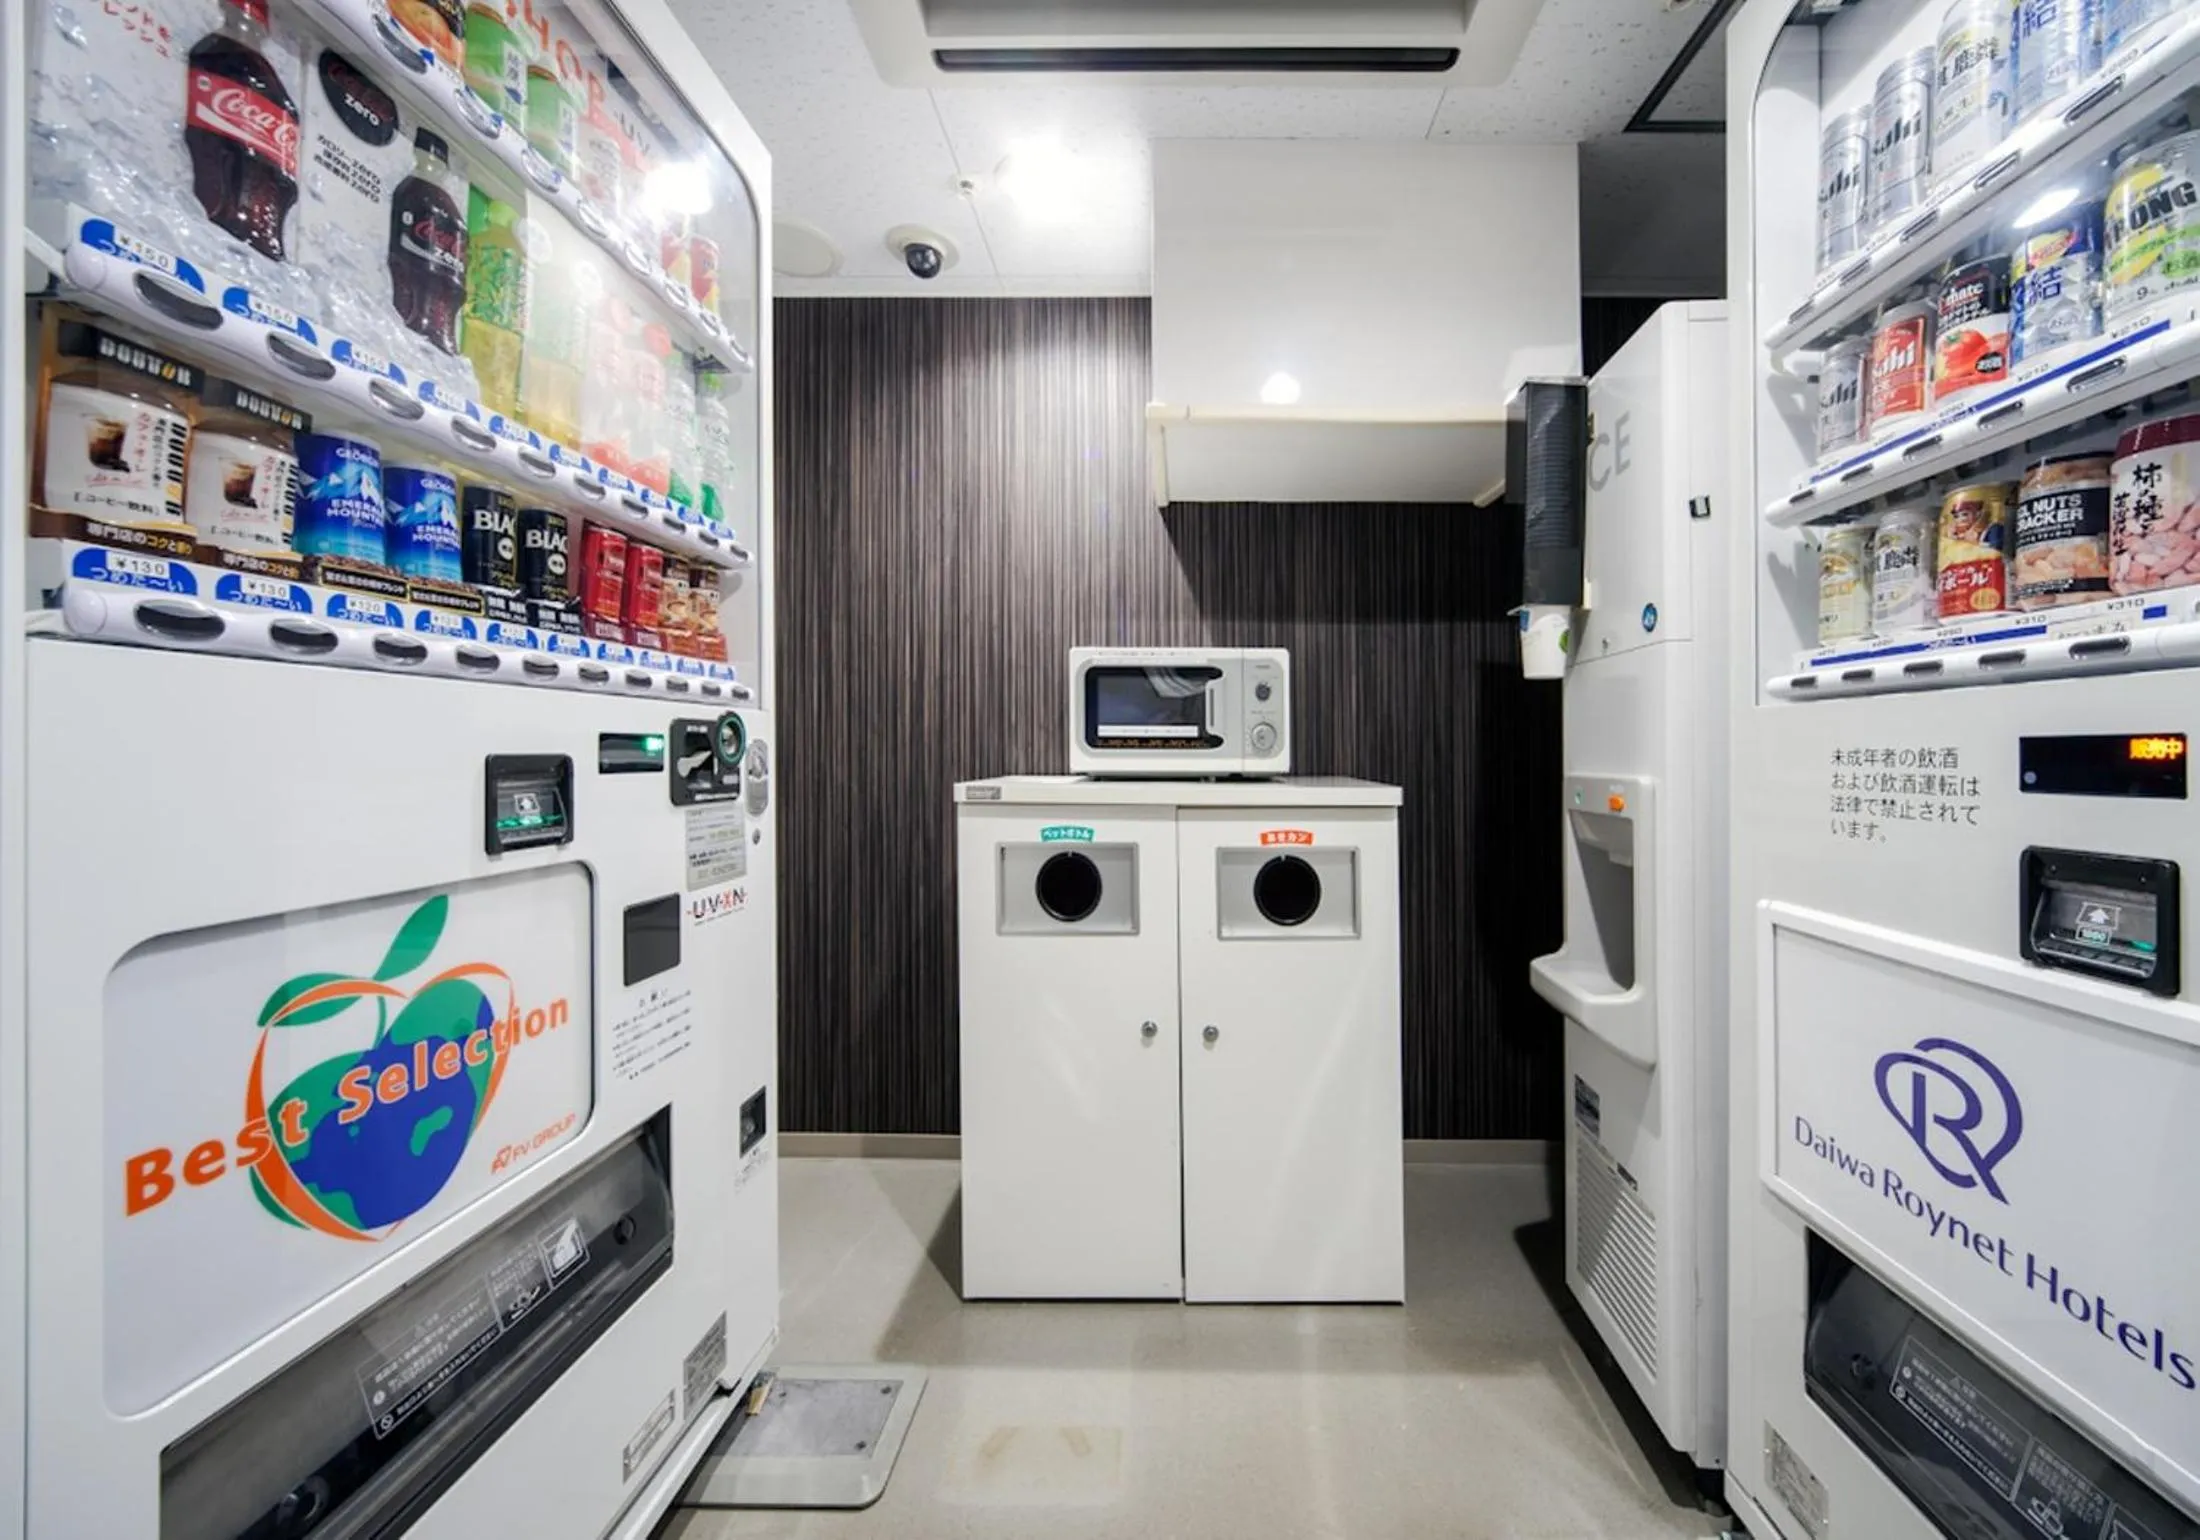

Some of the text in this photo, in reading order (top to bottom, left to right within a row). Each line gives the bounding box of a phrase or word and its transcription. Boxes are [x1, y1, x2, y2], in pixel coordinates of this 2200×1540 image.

[1588, 409, 1631, 492] CE
[526, 528, 568, 553] BLAC
[117, 558, 165, 576] ¥130
[248, 580, 288, 598] ¥130
[2107, 598, 2145, 611] ¥310
[2015, 614, 2047, 625] ¥310
[1831, 748, 1959, 769] 未成年者の飲酒
[1831, 772, 1981, 797] および飲酒運転は
[1831, 796, 1981, 826] 法律で禁止されて
[1830, 819, 1886, 843] います。
[126, 1098, 309, 1217] Best
[338, 997, 568, 1125] Selection
[1794, 1115, 2197, 1391] Daiwa Roynet Hotels
